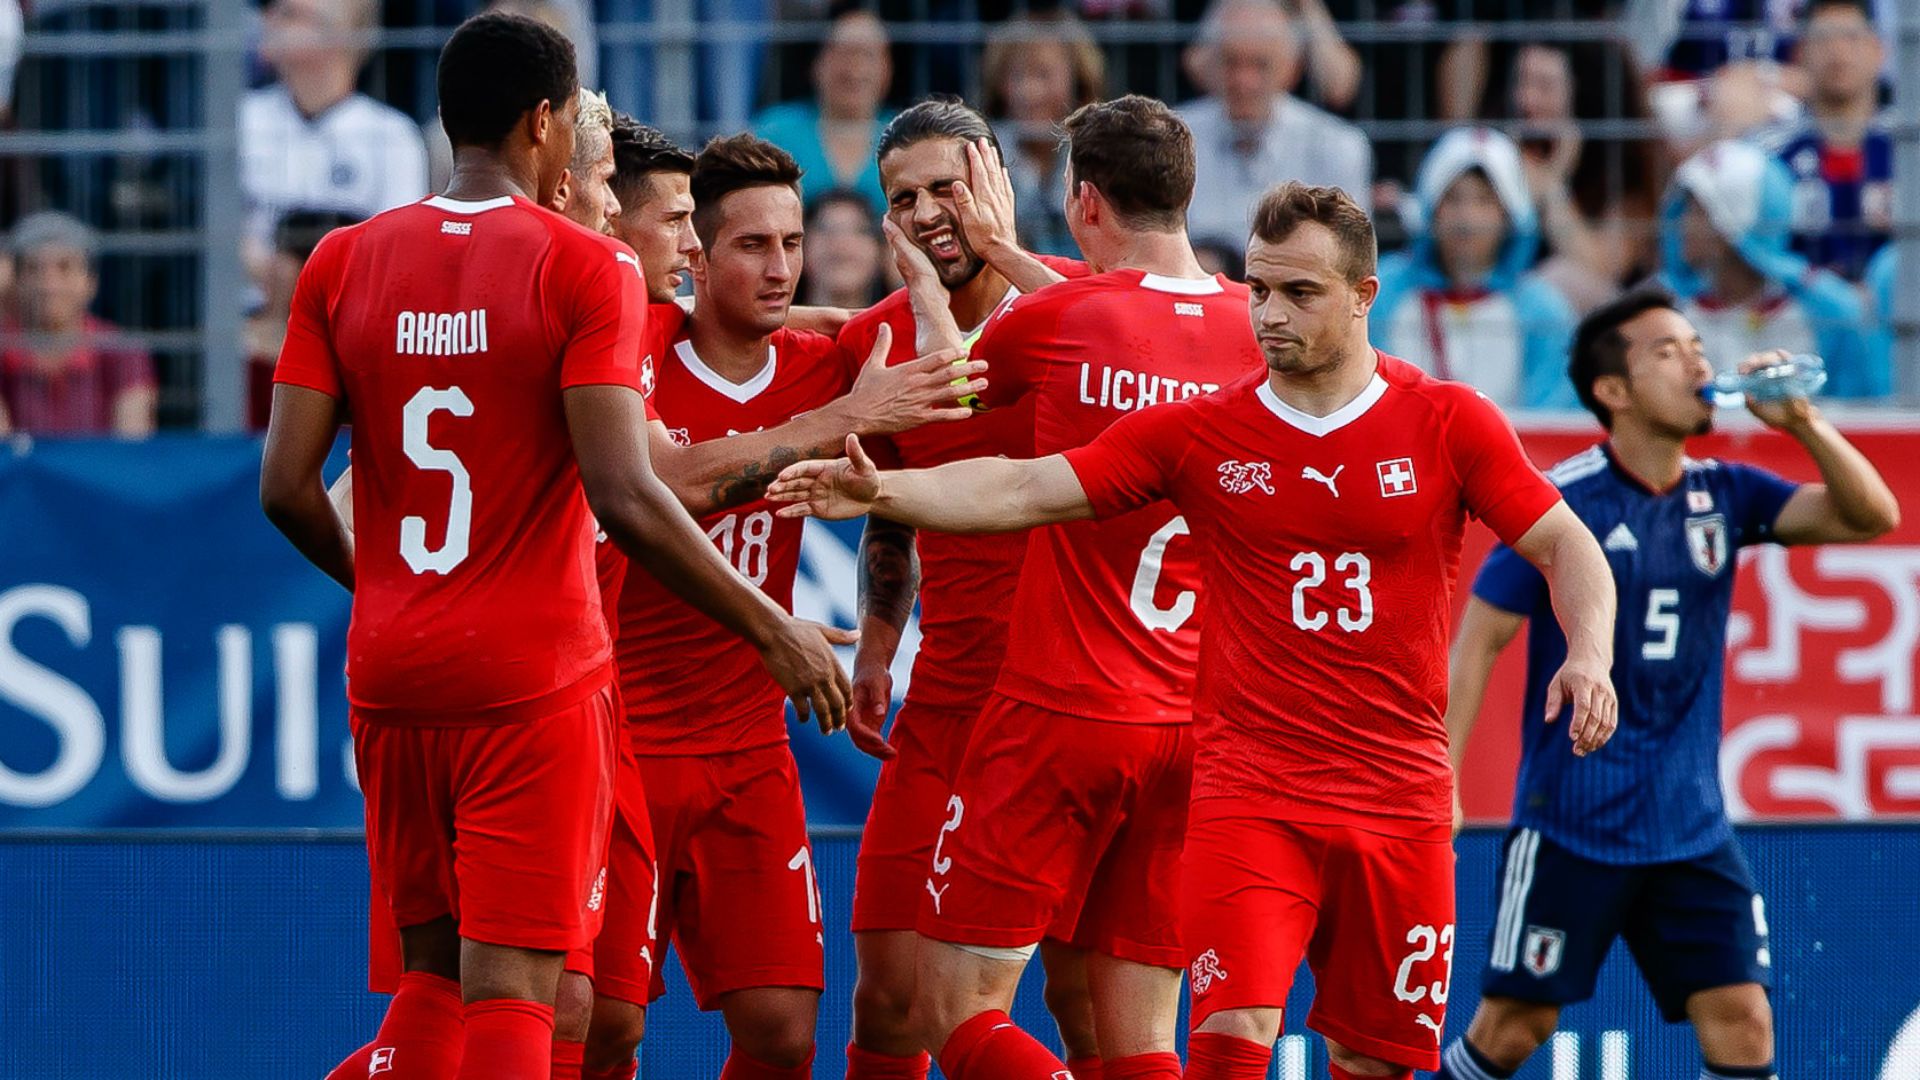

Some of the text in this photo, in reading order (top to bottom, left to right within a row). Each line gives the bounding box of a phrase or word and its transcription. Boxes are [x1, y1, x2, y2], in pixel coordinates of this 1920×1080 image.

[397, 309, 487, 355] AKANJI
[400, 386, 474, 574] 5
[706, 511, 773, 588] 18
[1290, 551, 1373, 632] 23
[1642, 588, 1679, 660] 5
[933, 794, 964, 875] 2
[788, 845, 822, 923] 1
[1394, 923, 1455, 1005] 23
